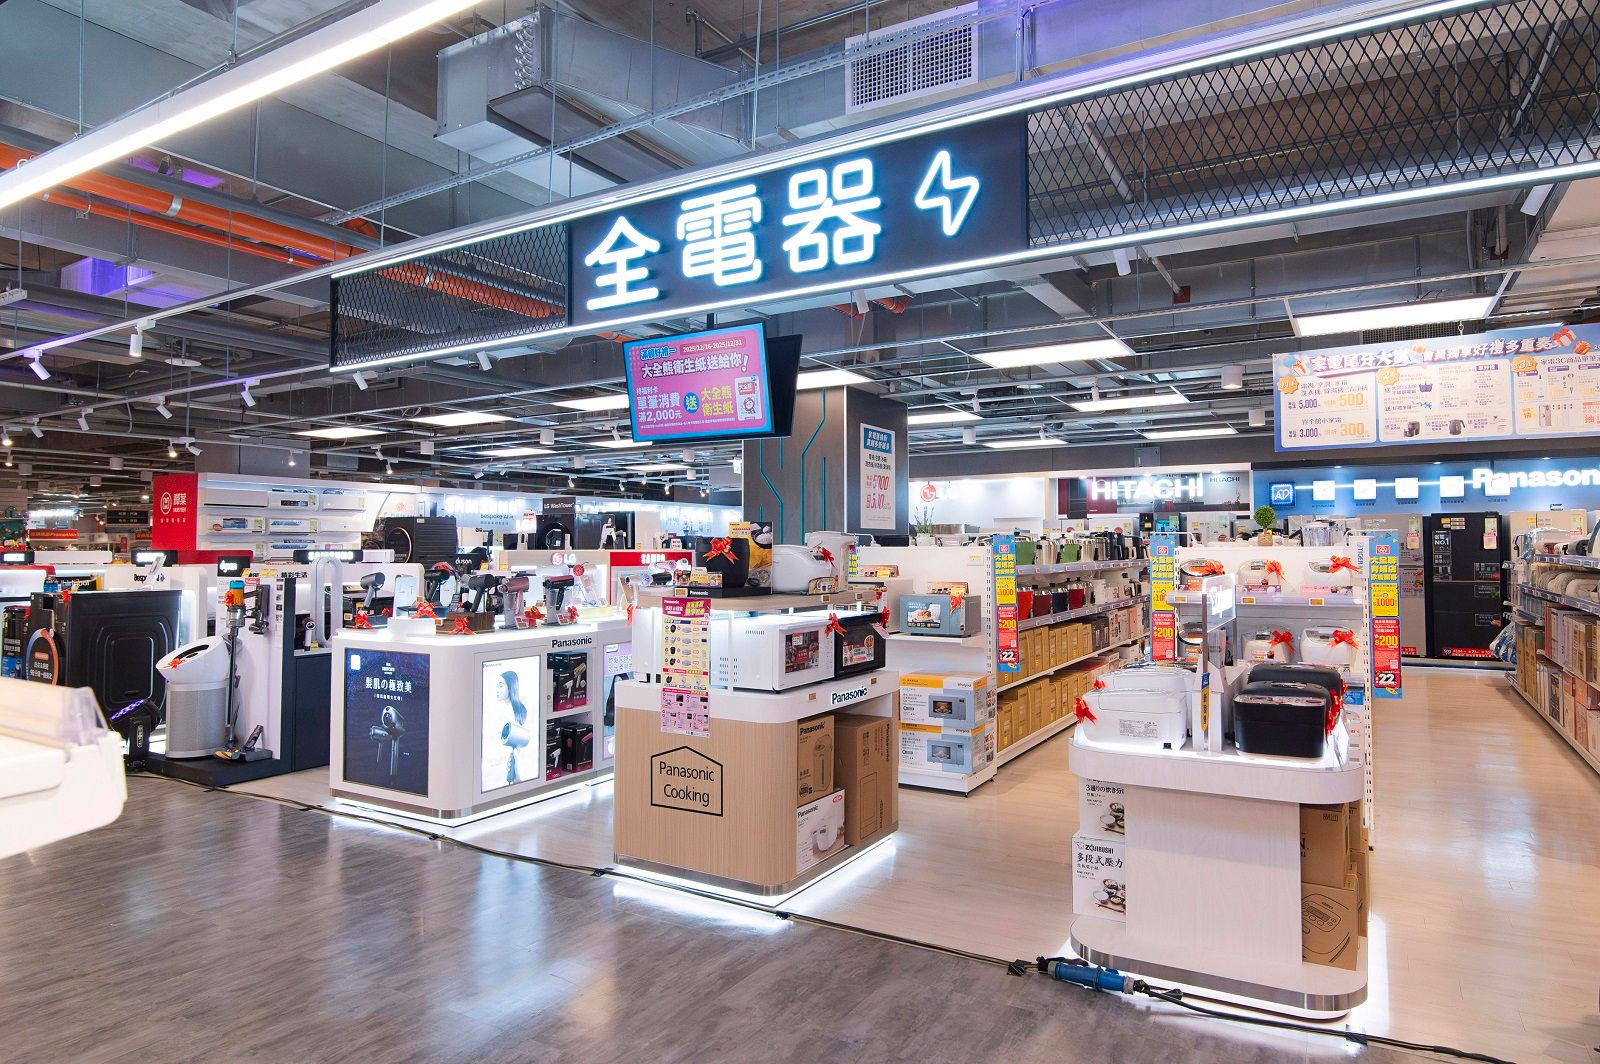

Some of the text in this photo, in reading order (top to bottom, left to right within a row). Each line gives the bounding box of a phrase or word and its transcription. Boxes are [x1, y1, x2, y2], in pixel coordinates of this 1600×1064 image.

[585, 158, 881, 312] 全電器
[641, 351, 749, 378] 大全熊衛生紙送給你!
[700, 385, 733, 401] 大全熊
[1339, 393, 1364, 406] 500
[637, 393, 681, 410] 單筆消費
[685, 395, 698, 411] 送
[702, 400, 734, 417] 衛生紙
[638, 409, 682, 424] 滿2,000元
[1340, 422, 1364, 436] 300
[1091, 477, 1204, 501] HITACHI
[562, 553, 577, 564] LG
[551, 635, 593, 649] Panasonic
[365, 677, 412, 693] 髮肌の極致美
[831, 685, 868, 705] Panasonic
[799, 721, 826, 736] Panasonic
[659, 761, 715, 782] Panasonic
[663, 784, 710, 807] Cooking
[797, 804, 819, 819] Panasonic
[1085, 843, 1114, 855] ZOJIRUSHI
[1077, 852, 1123, 869] 多段式壓力
